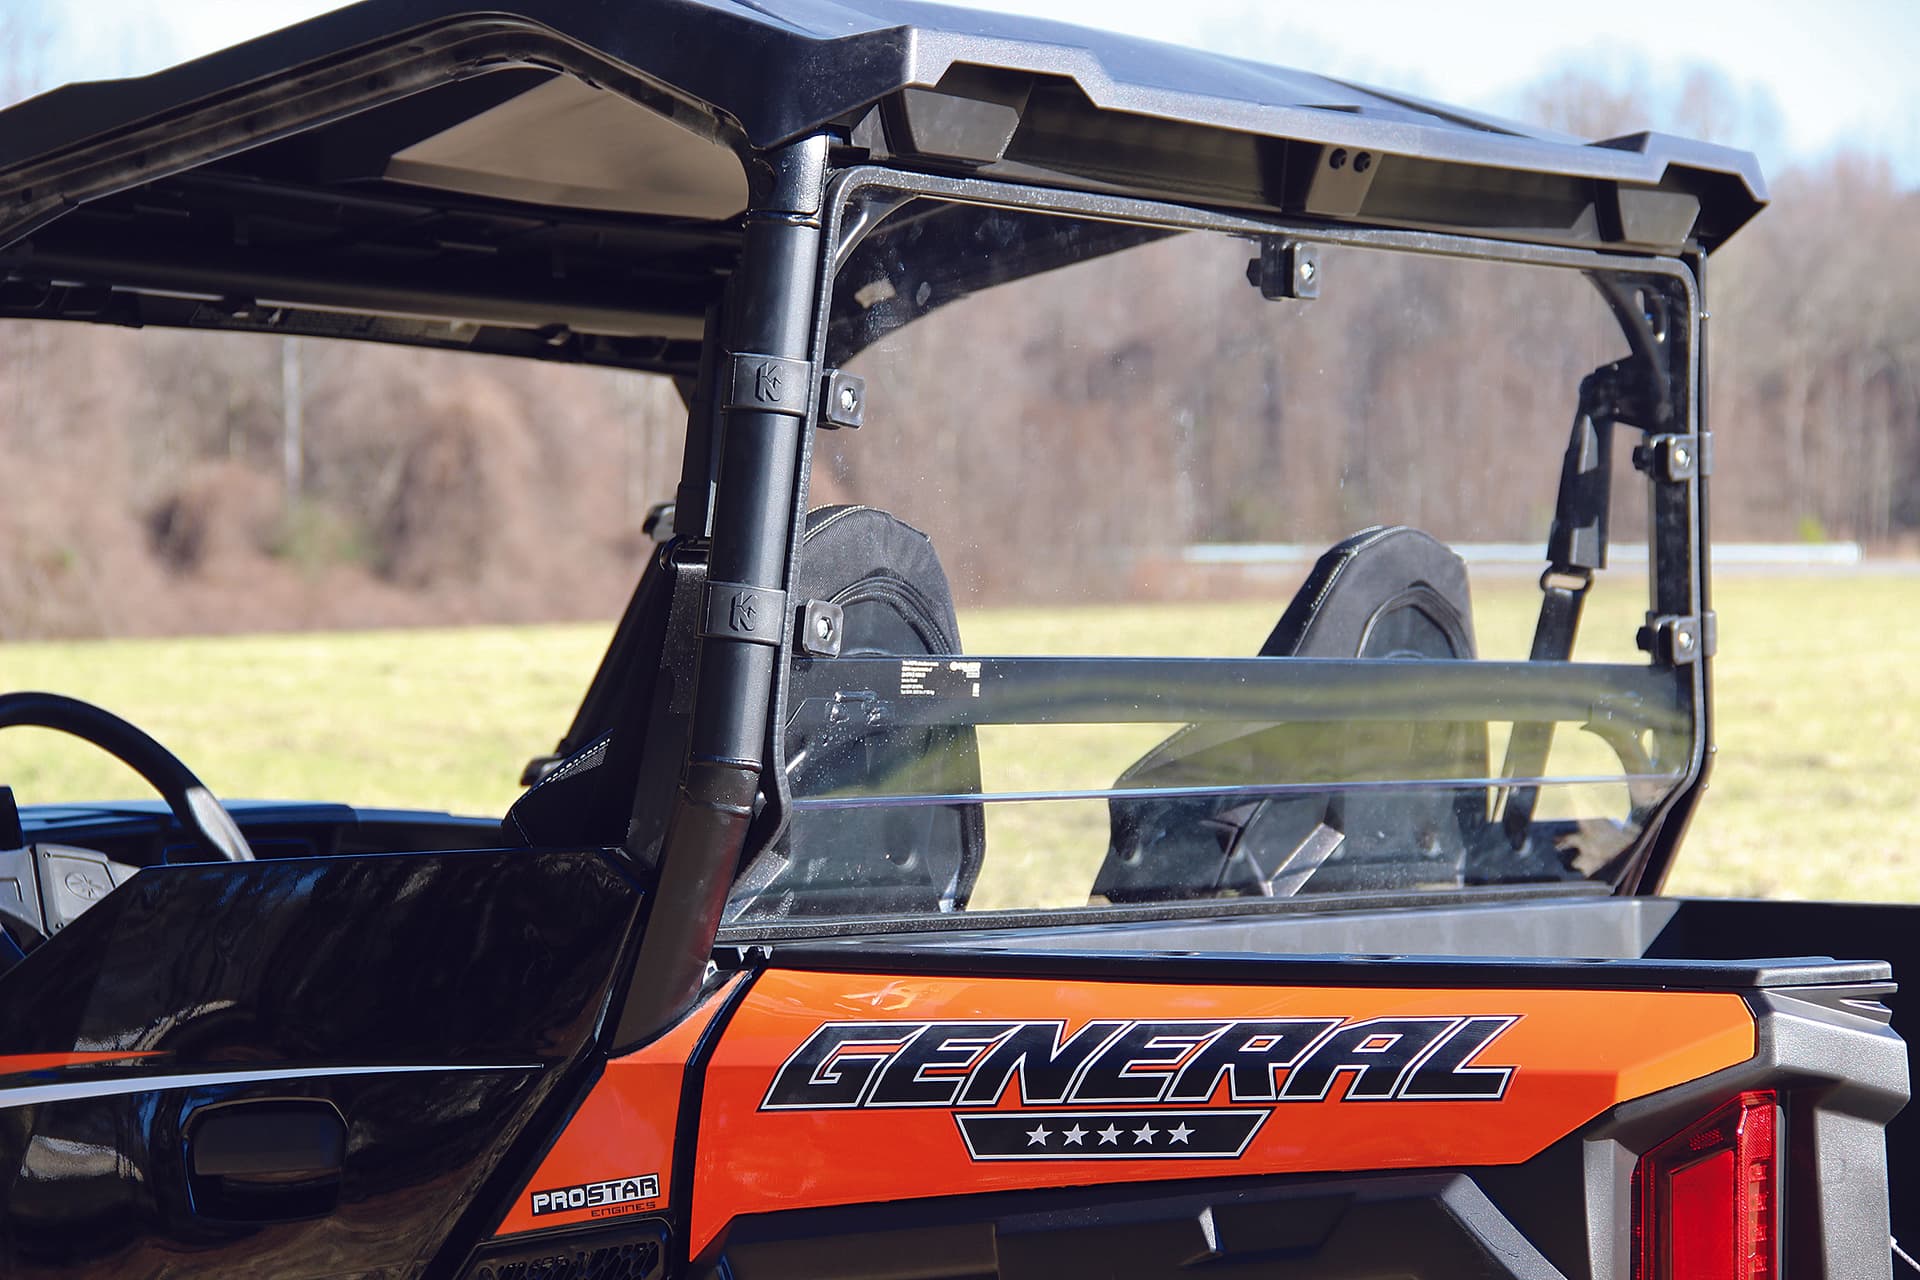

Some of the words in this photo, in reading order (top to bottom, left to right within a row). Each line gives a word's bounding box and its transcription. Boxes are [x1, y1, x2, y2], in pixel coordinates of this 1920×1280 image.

[757, 1014, 1525, 1112] GENERAL
[532, 1174, 659, 1214] PROSTAR
[591, 1201, 656, 1217] ENGINES
